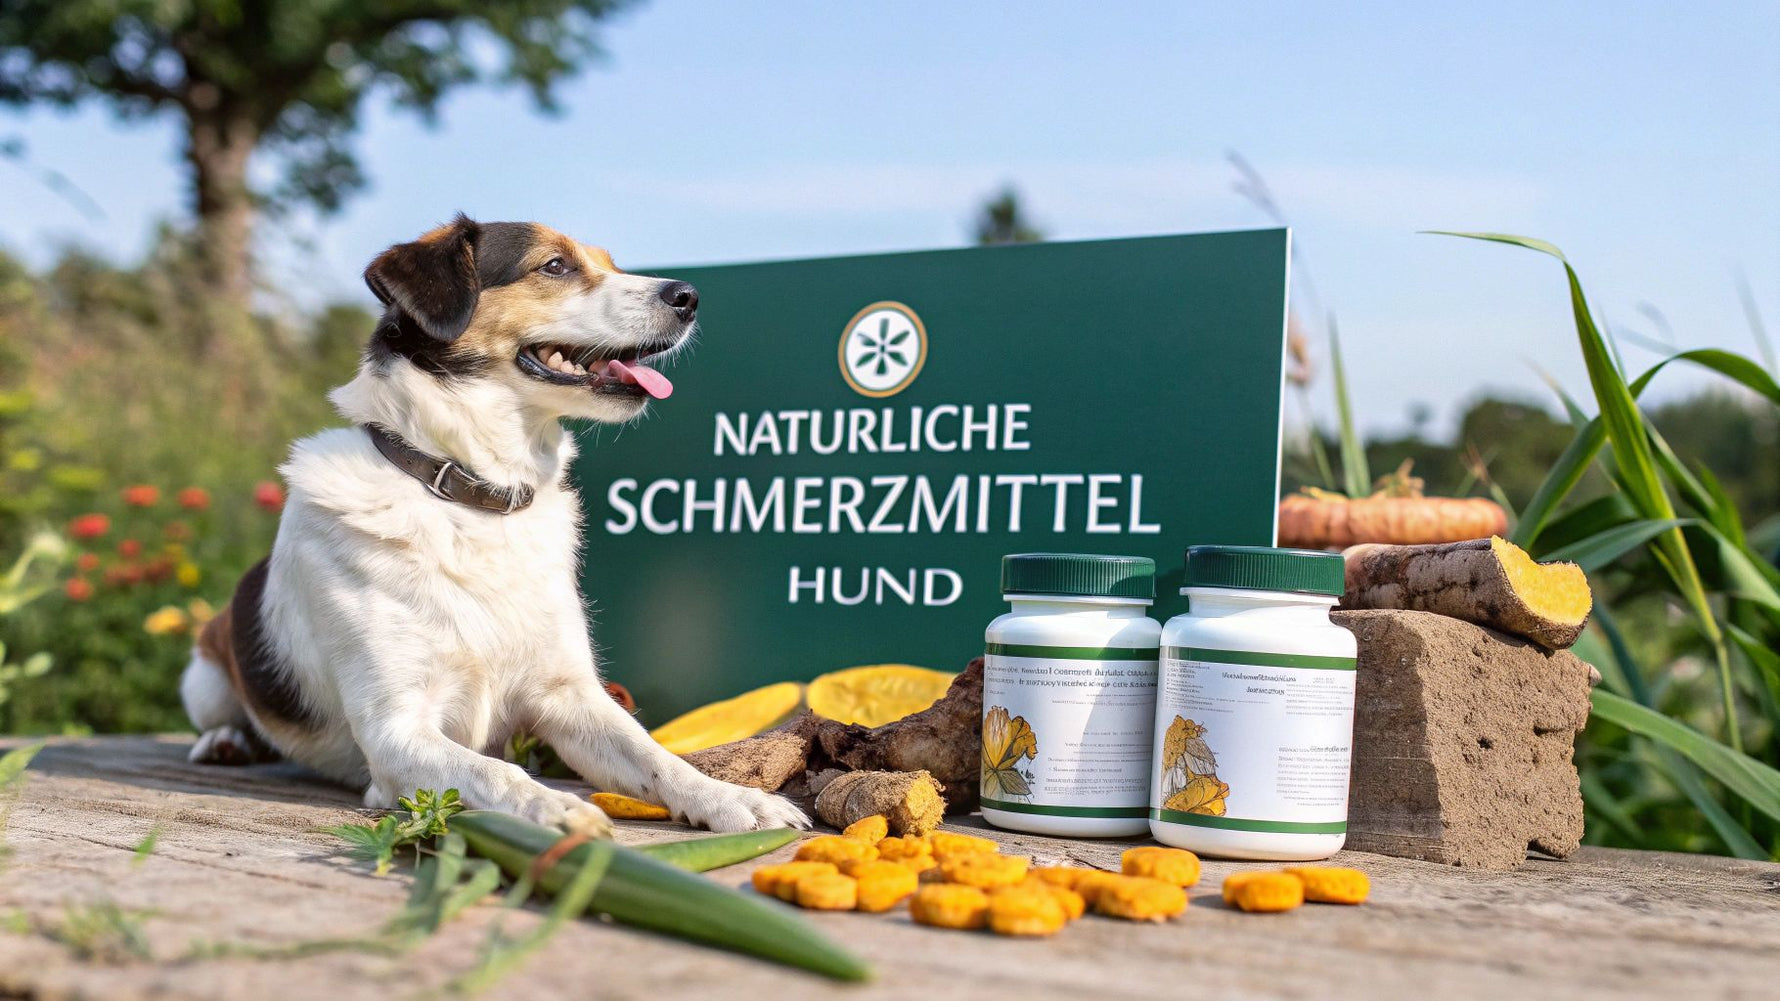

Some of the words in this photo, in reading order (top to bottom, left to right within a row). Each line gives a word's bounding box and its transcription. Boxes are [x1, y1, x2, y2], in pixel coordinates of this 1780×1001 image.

[714, 403, 1031, 456] NATURLICHE
[606, 474, 1161, 534] SCHMERZMITTEL
[788, 566, 963, 606] HUND
